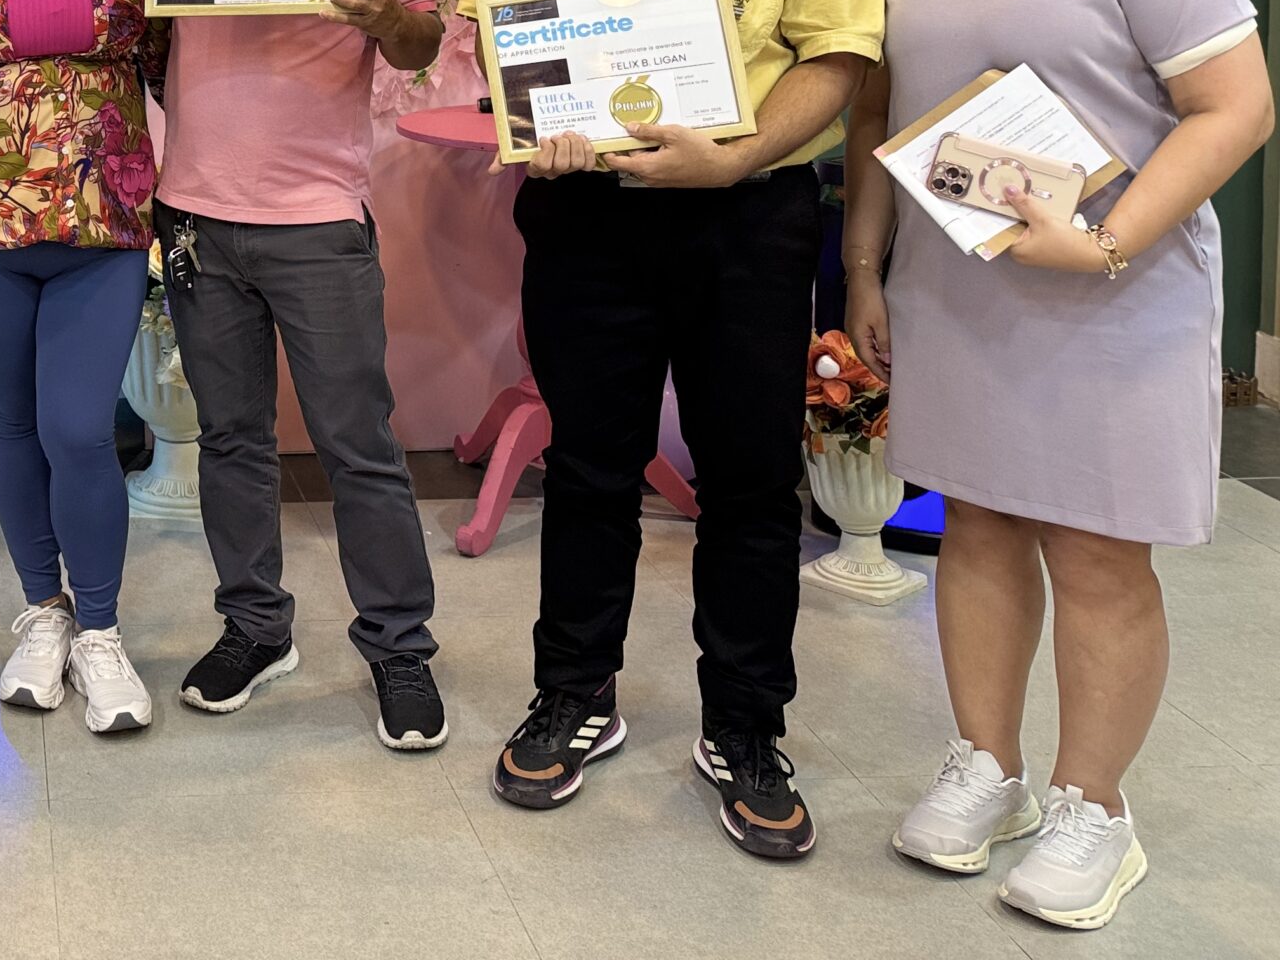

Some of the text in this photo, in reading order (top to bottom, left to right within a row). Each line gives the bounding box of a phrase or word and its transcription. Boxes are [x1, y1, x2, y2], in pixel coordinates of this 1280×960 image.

[495, 16, 634, 49] Certificate
[510, 45, 565, 58] APPRECIATION
[610, 60, 640, 71] FELIX
[653, 53, 687, 66] LIGAN
[537, 92, 576, 104] CHECK
[539, 100, 594, 115] VOUCHER
